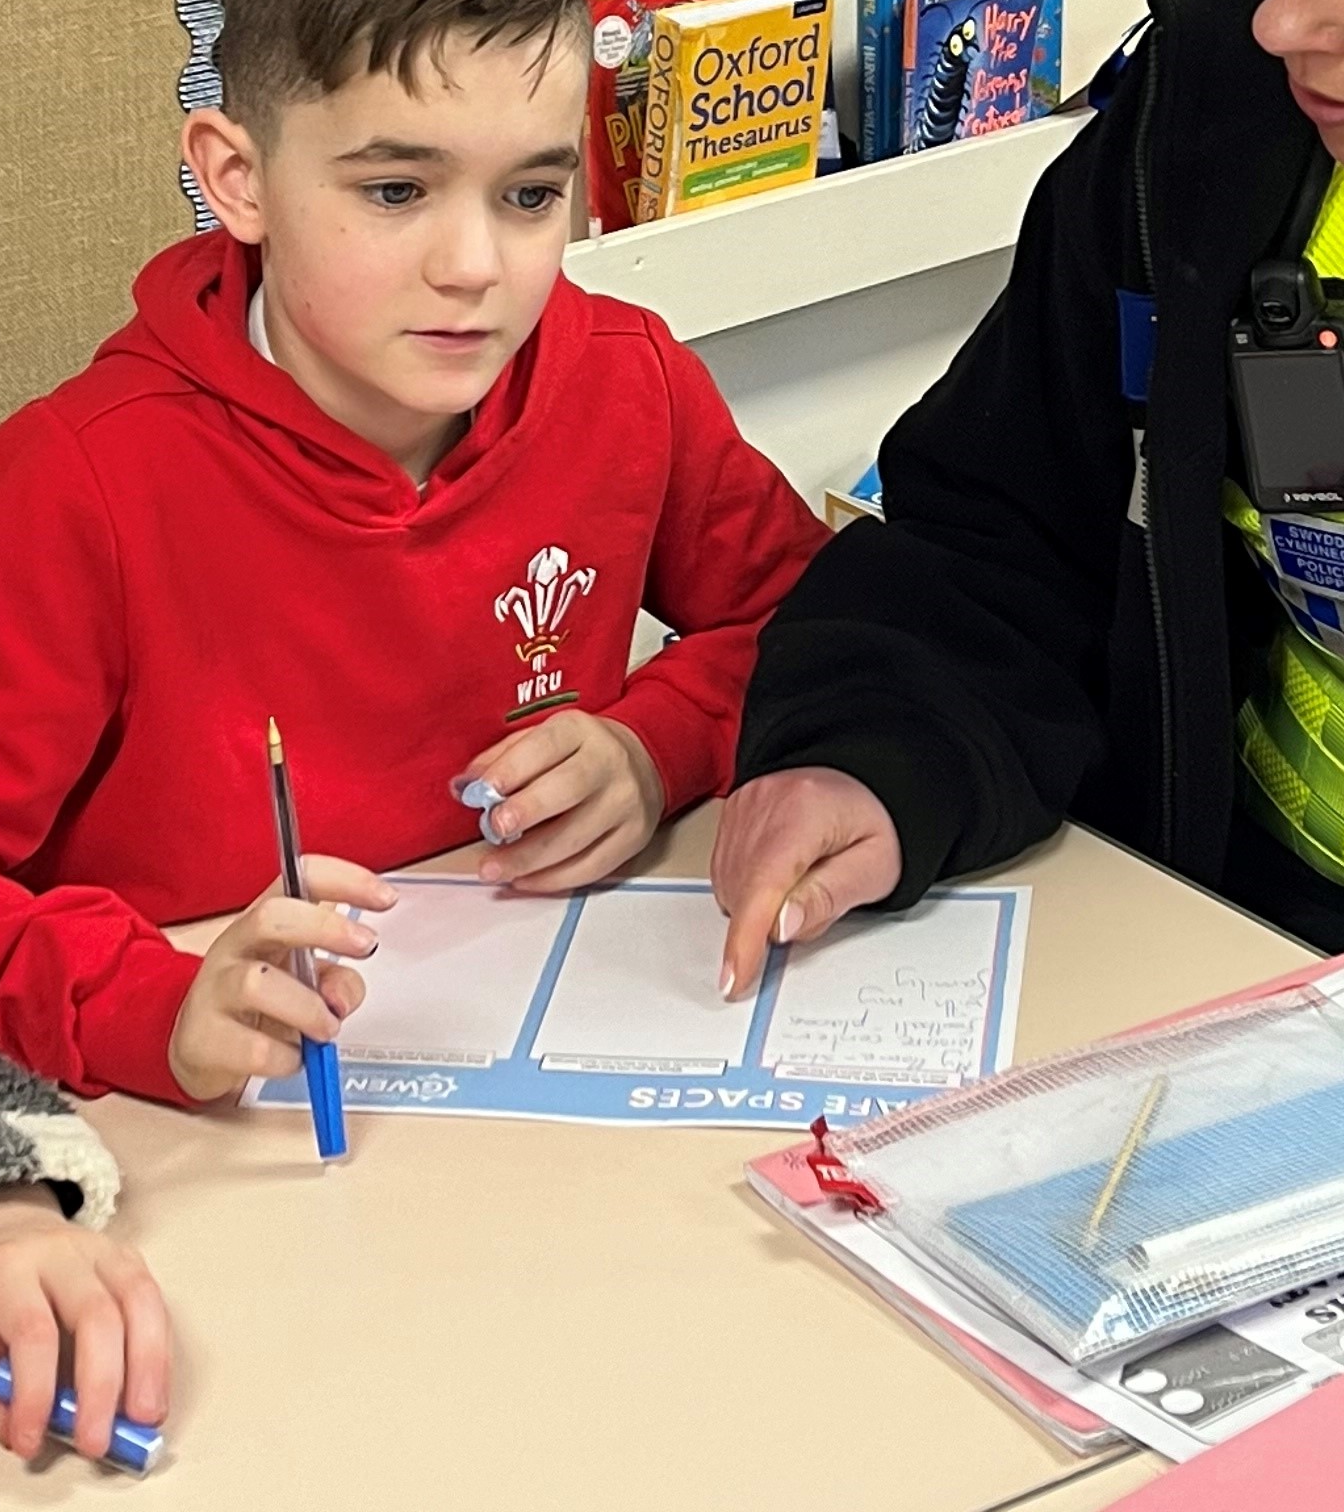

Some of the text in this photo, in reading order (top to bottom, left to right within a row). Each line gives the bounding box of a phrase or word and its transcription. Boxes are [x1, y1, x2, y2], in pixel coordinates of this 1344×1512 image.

[984, 2, 1037, 48] Harry
[694, 23, 821, 86] Oxford
[991, 36, 1017, 68] the
[641, 34, 674, 178] OXFORD
[688, 65, 816, 133] School
[685, 114, 812, 164] Thesaurus
[516, 670, 564, 705] WRU
[893, 967, 990, 1001] family
[627, 1083, 912, 1120] AFE SPACES
